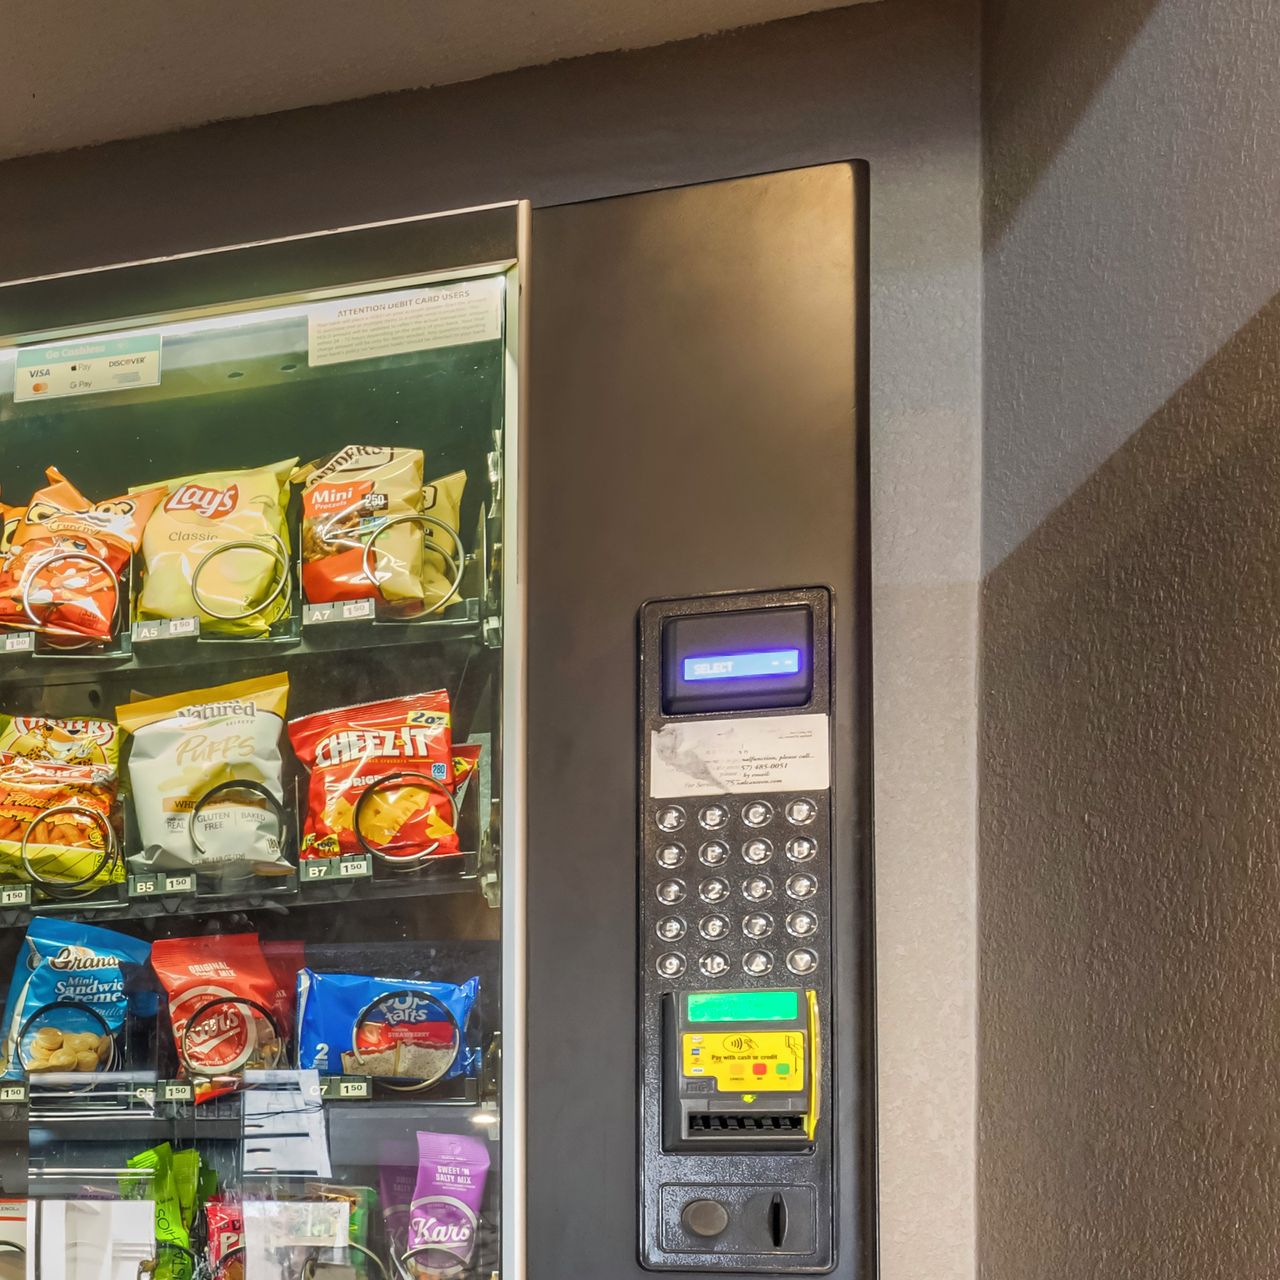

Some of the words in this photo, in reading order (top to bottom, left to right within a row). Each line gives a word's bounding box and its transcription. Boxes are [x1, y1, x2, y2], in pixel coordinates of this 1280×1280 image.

[337, 303, 386, 318] ATTENTION
[387, 297, 413, 310] DEBIT
[414, 295, 440, 305] CARD
[441, 289, 470, 301] USERS
[108, 356, 146, 368] DISCOVER
[29, 368, 51, 378] VISA
[166, 484, 235, 518] Lay's
[312, 487, 353, 504] Mini
[365, 493, 386, 507] 250
[314, 500, 347, 511] Pretzels
[168, 531, 219, 542] Classic
[312, 609, 331, 621] A7
[141, 627, 158, 638] A5
[694, 661, 734, 675] SELECT
[411, 712, 425, 724] 2
[316, 726, 429, 768] CHEEZ-IT
[196, 811, 230, 823] GLUTEN
[241, 811, 266, 821] BAKED
[748, 807, 765, 823] C
[167, 821, 185, 829] REAL
[204, 821, 224, 832] FREE
[309, 867, 328, 877] B7
[136, 881, 154, 892] B5
[708, 883, 722, 899] 2
[665, 921, 680, 938] 5
[708, 919, 722, 936] 6
[188, 961, 230, 973] ORIGINAL
[666, 957, 680, 973] 9
[704, 956, 725, 973] 10
[67, 975, 94, 985] Mini
[386, 1008, 429, 1025] tarts
[315, 1042, 329, 1060] 2
[457, 1176, 472, 1184] MIX
[412, 1217, 471, 1244] Kar's
